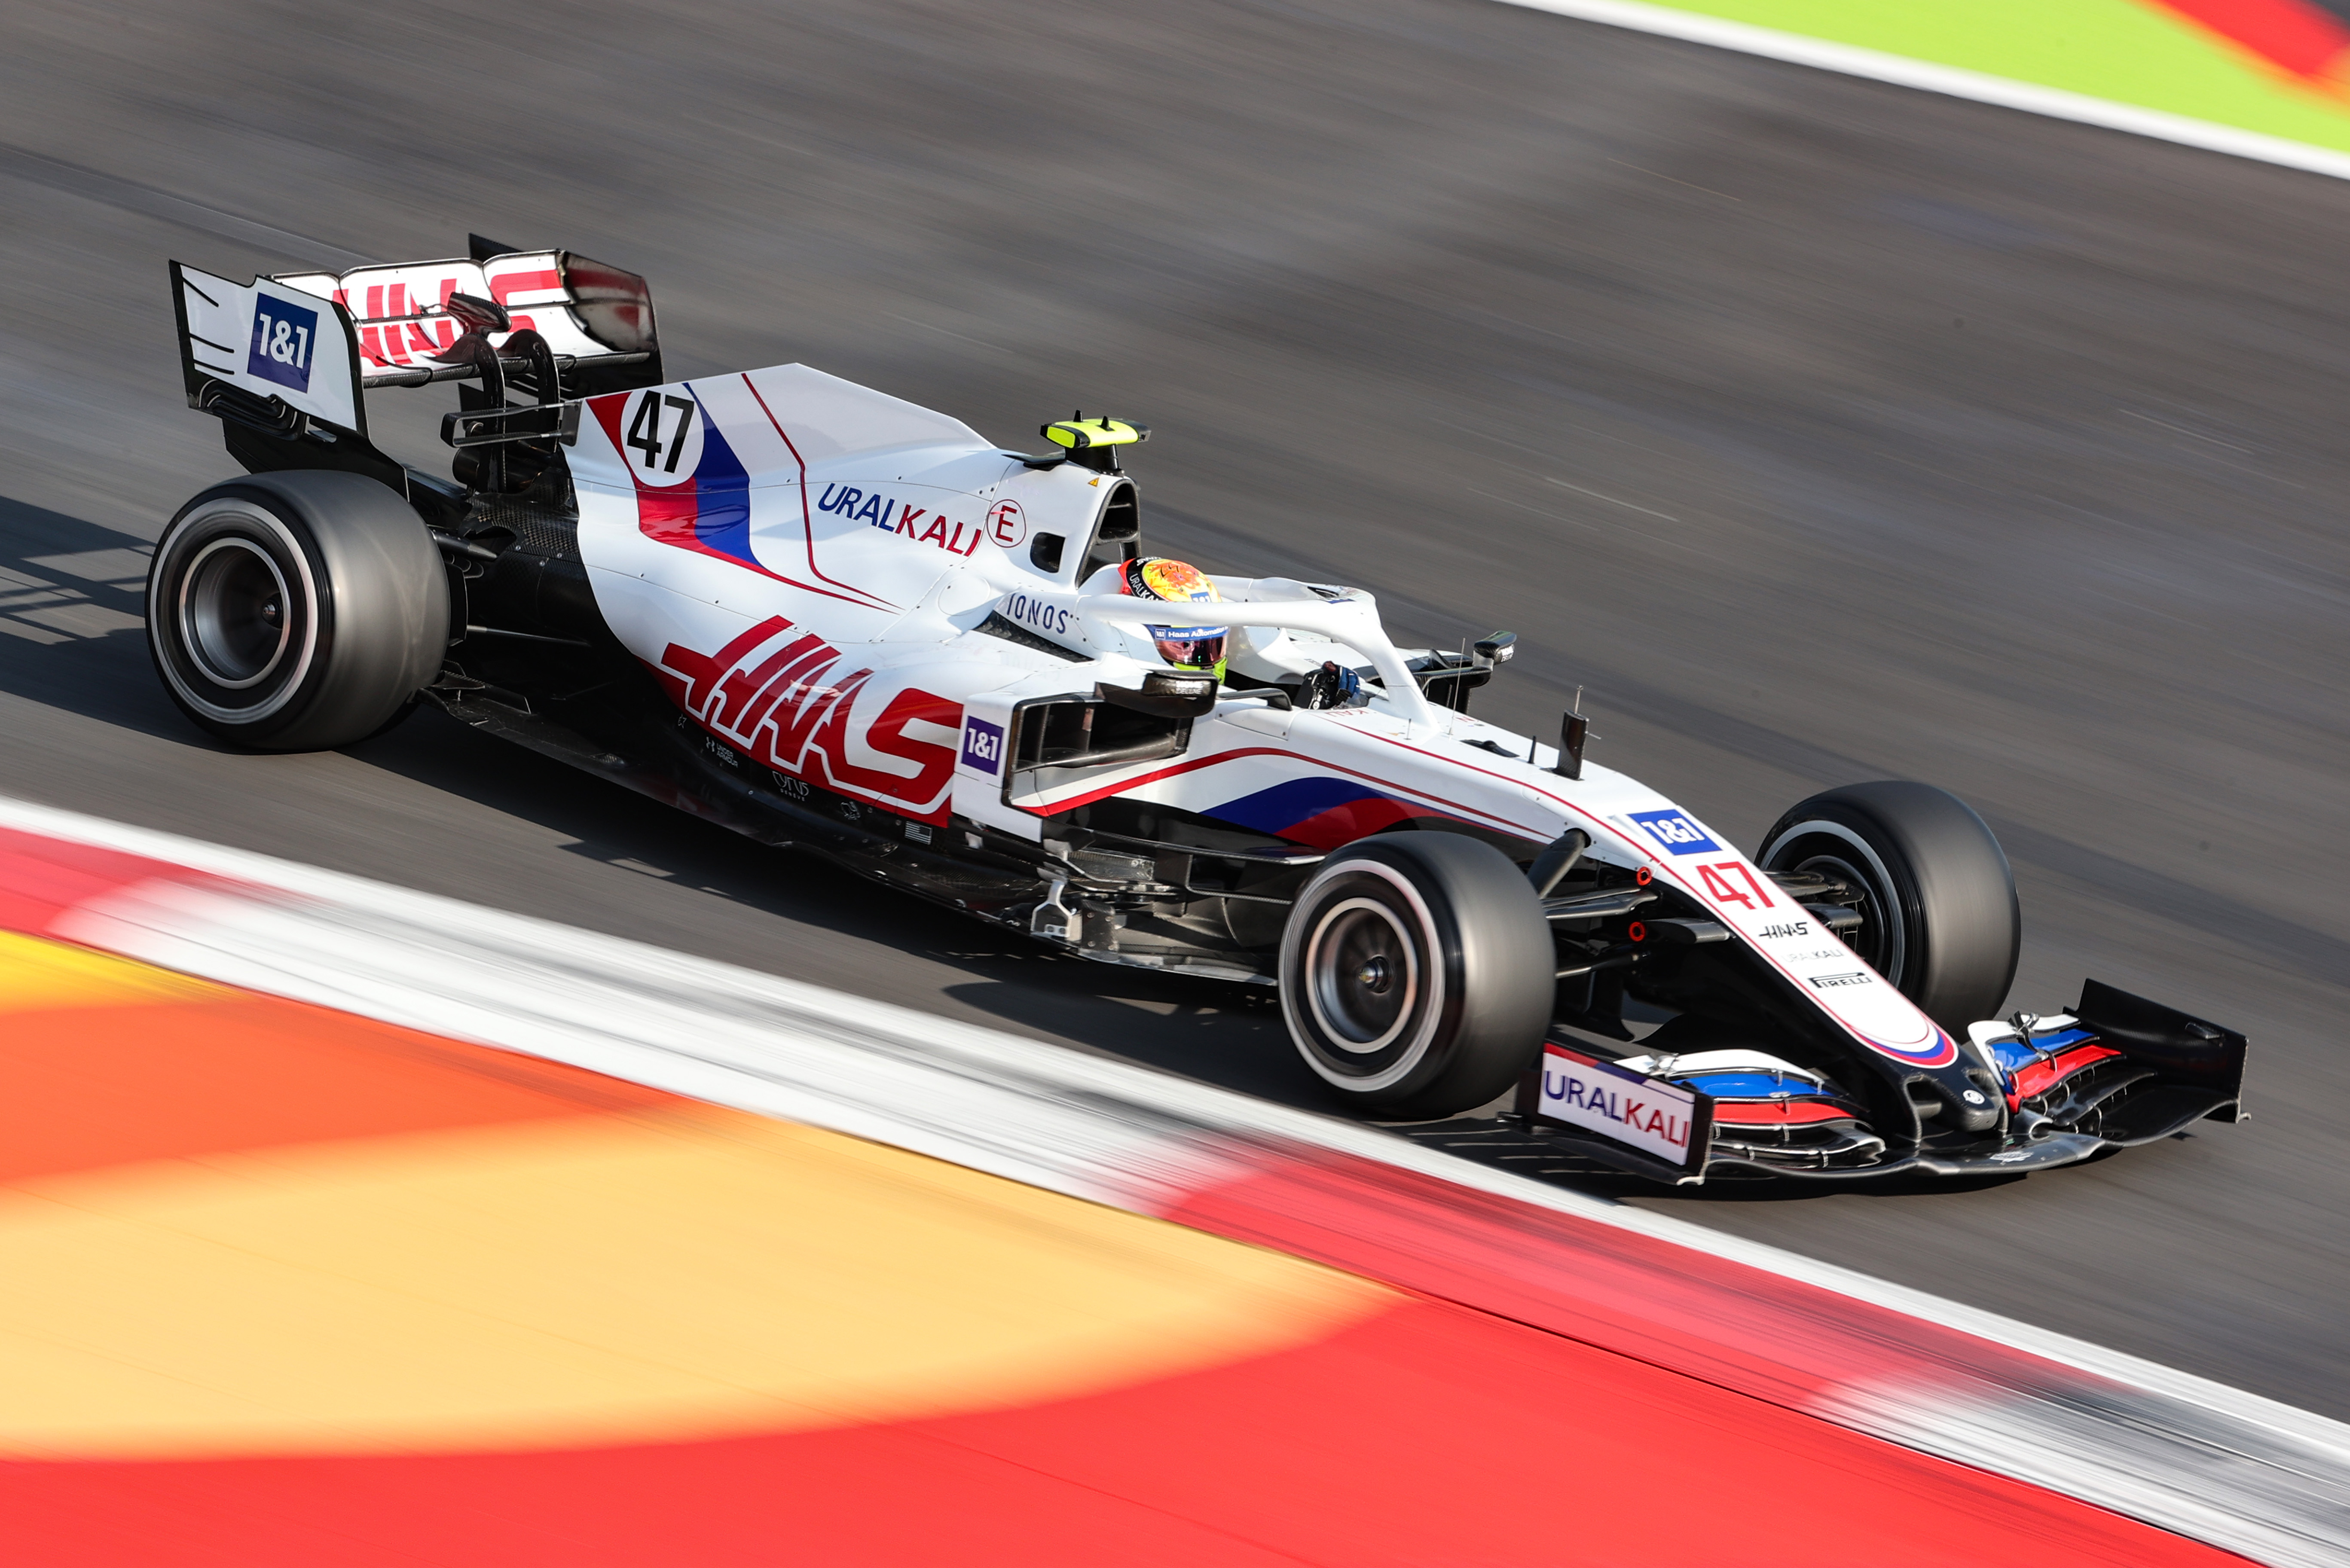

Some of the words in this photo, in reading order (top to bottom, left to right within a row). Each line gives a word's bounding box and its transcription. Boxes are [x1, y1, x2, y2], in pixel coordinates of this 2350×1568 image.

[259, 312, 309, 369] 1&1
[627, 390, 694, 473] 47
[818, 483, 982, 557] URALKALI
[996, 505, 1017, 542] E
[1130, 574, 1160, 600] URALKA
[1007, 593, 1068, 634] IONOS
[661, 614, 964, 813] HAAS
[716, 743, 733, 759] UNDER
[716, 750, 738, 768] ARMOUR
[968, 727, 999, 761] 1&1
[1641, 817, 1705, 844] 1&1
[1696, 861, 1775, 910] 47
[1758, 921, 1809, 939] HAAS
[1781, 949, 1844, 963] URALKALI
[1807, 972, 1873, 988] PIRELLI
[1545, 1070, 1689, 1147] URALKALI
